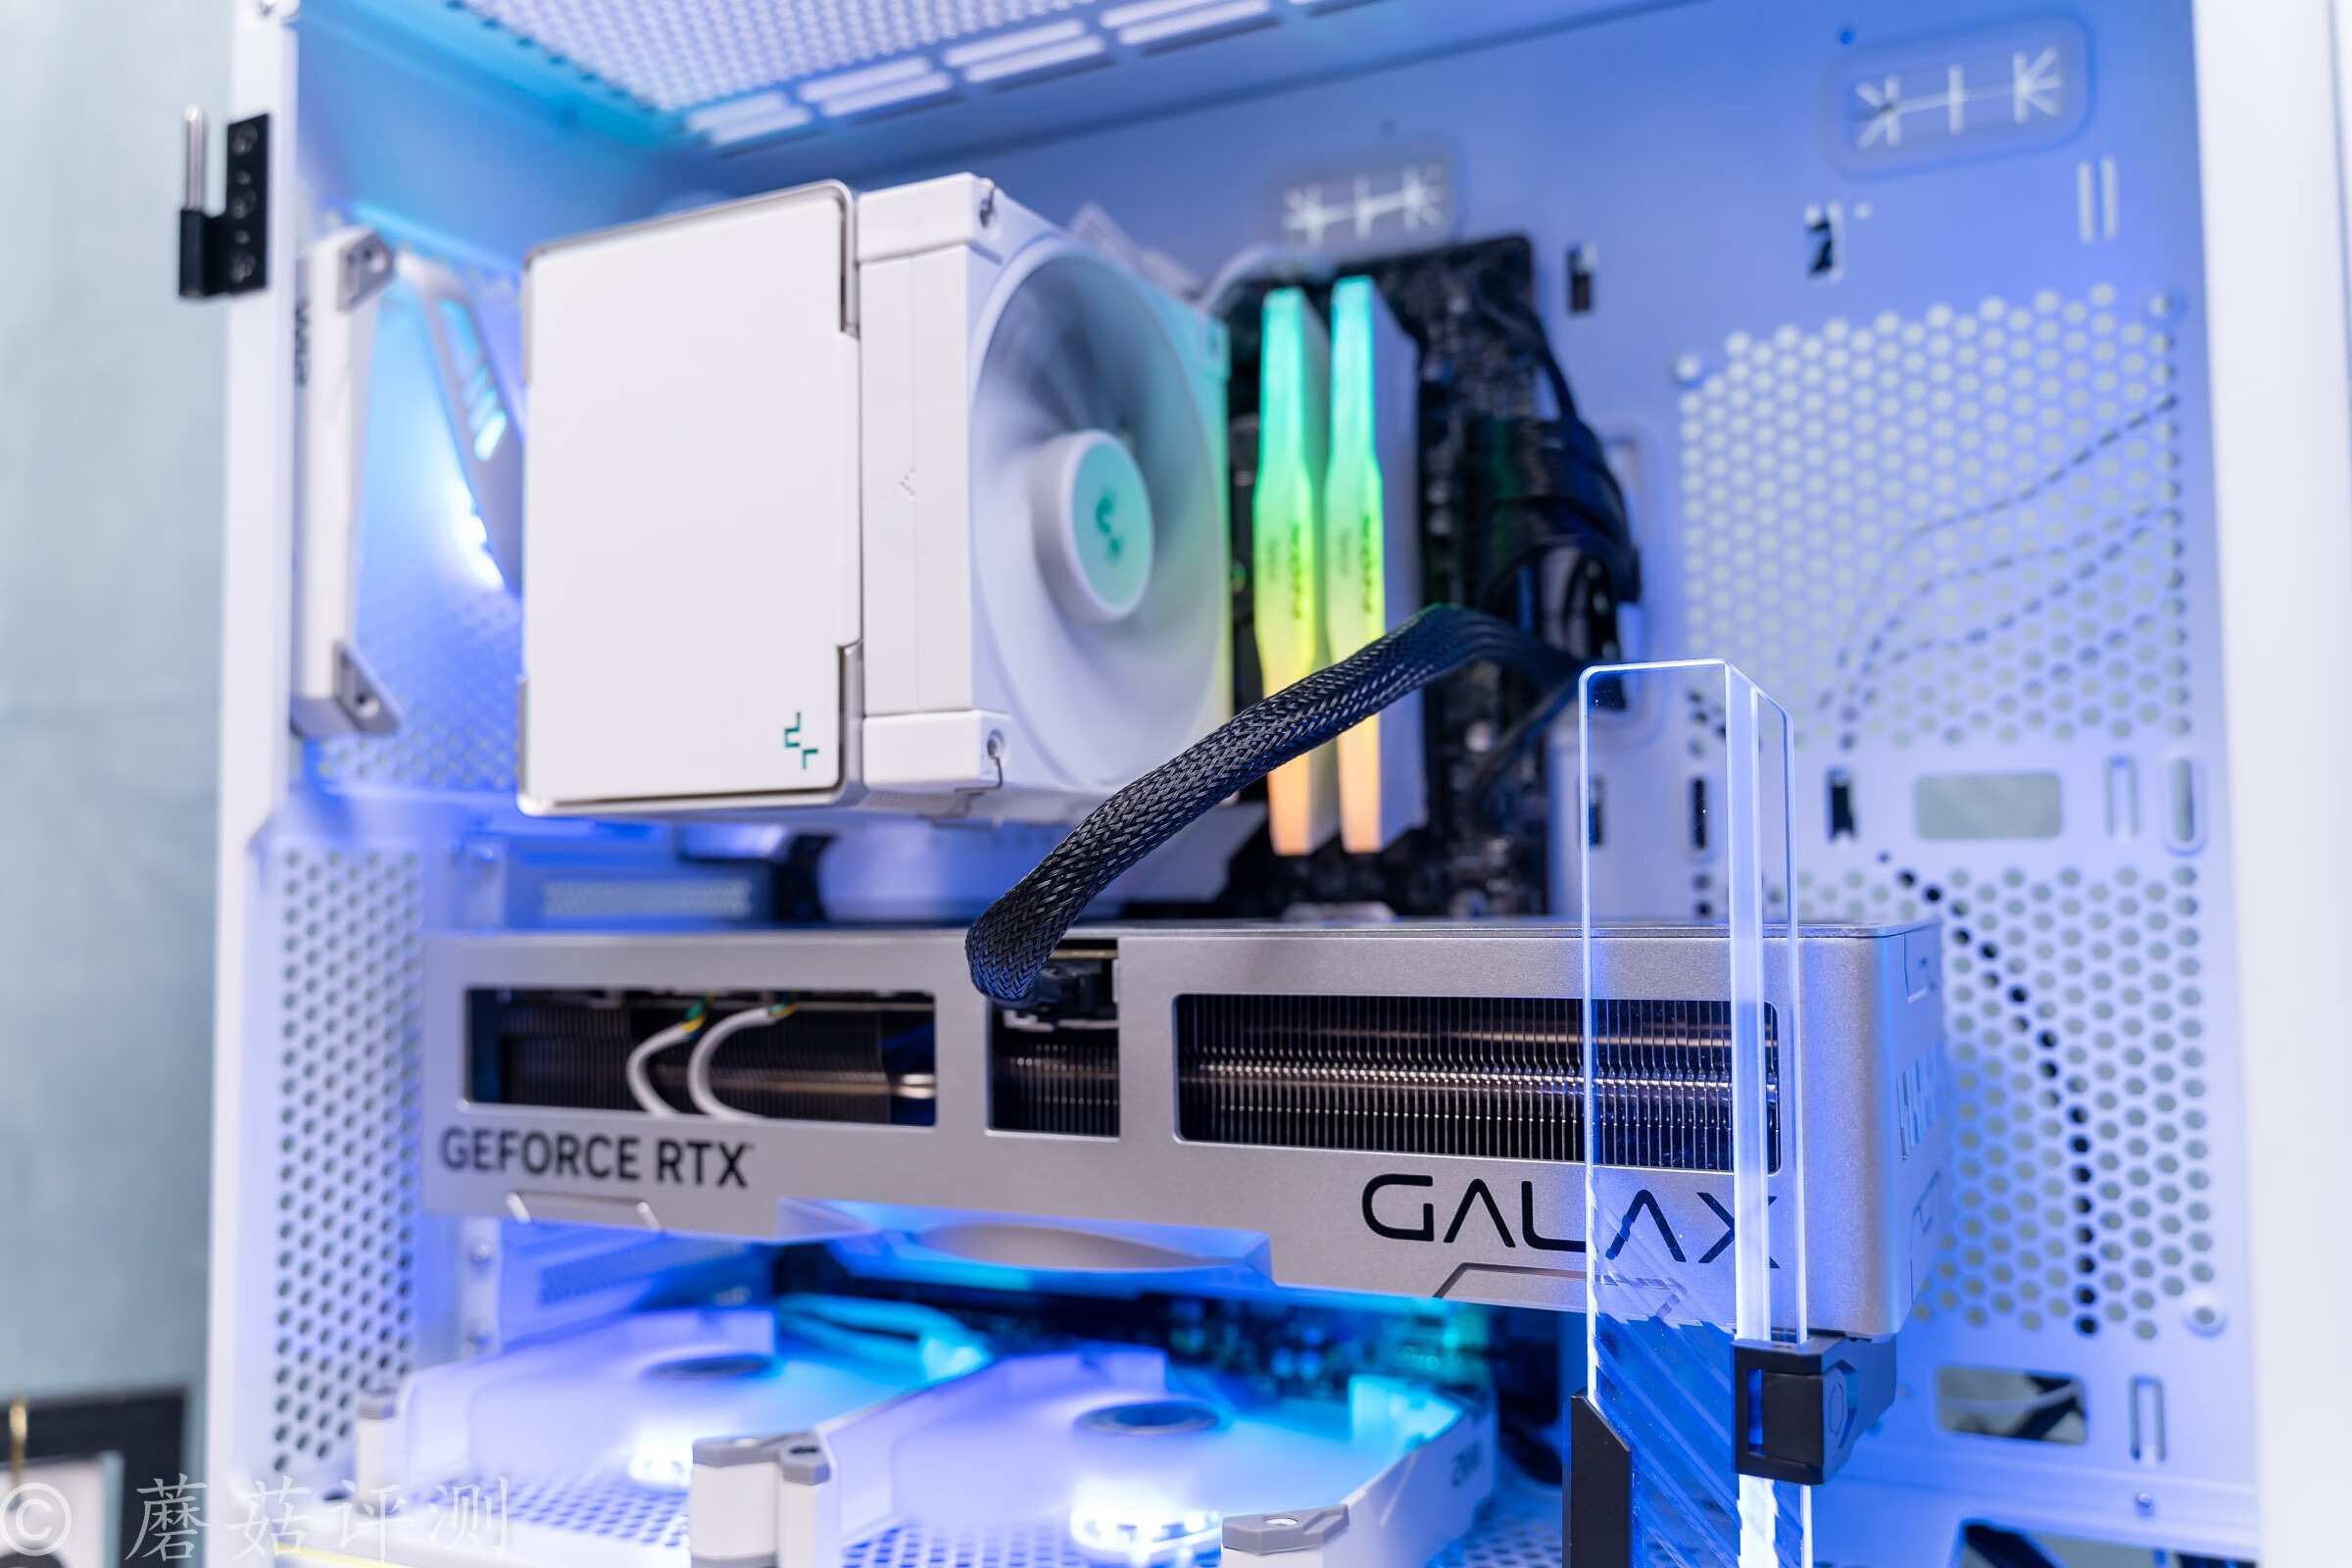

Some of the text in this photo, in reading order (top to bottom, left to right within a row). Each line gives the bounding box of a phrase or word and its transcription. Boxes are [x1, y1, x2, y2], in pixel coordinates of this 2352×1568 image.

[443, 1126, 749, 1189] GEFORCE RTX
[1362, 1173, 1781, 1269] GALAX
